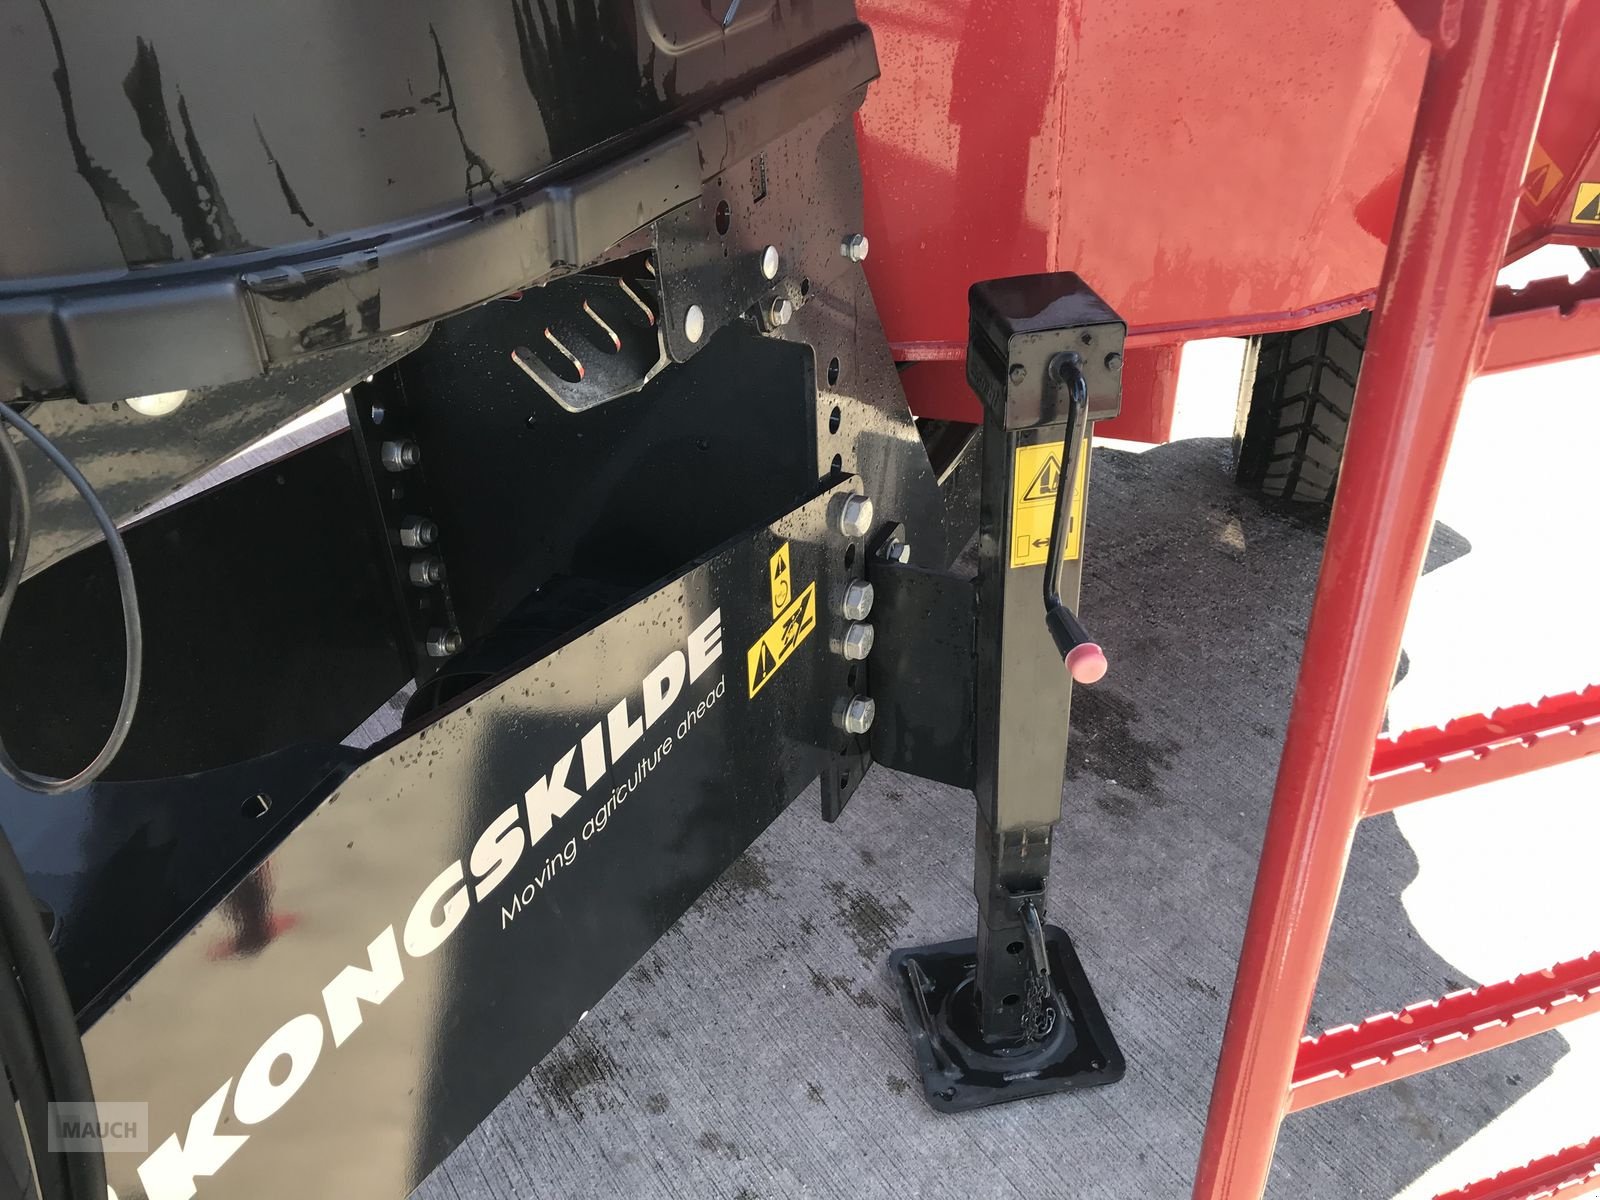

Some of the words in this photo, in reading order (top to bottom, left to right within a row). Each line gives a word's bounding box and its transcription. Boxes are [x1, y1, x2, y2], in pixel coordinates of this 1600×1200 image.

[137, 607, 722, 1200] KONGSKILDE
[501, 837, 577, 929] Moving
[582, 736, 673, 832] agriculture
[677, 674, 725, 740] ahead
